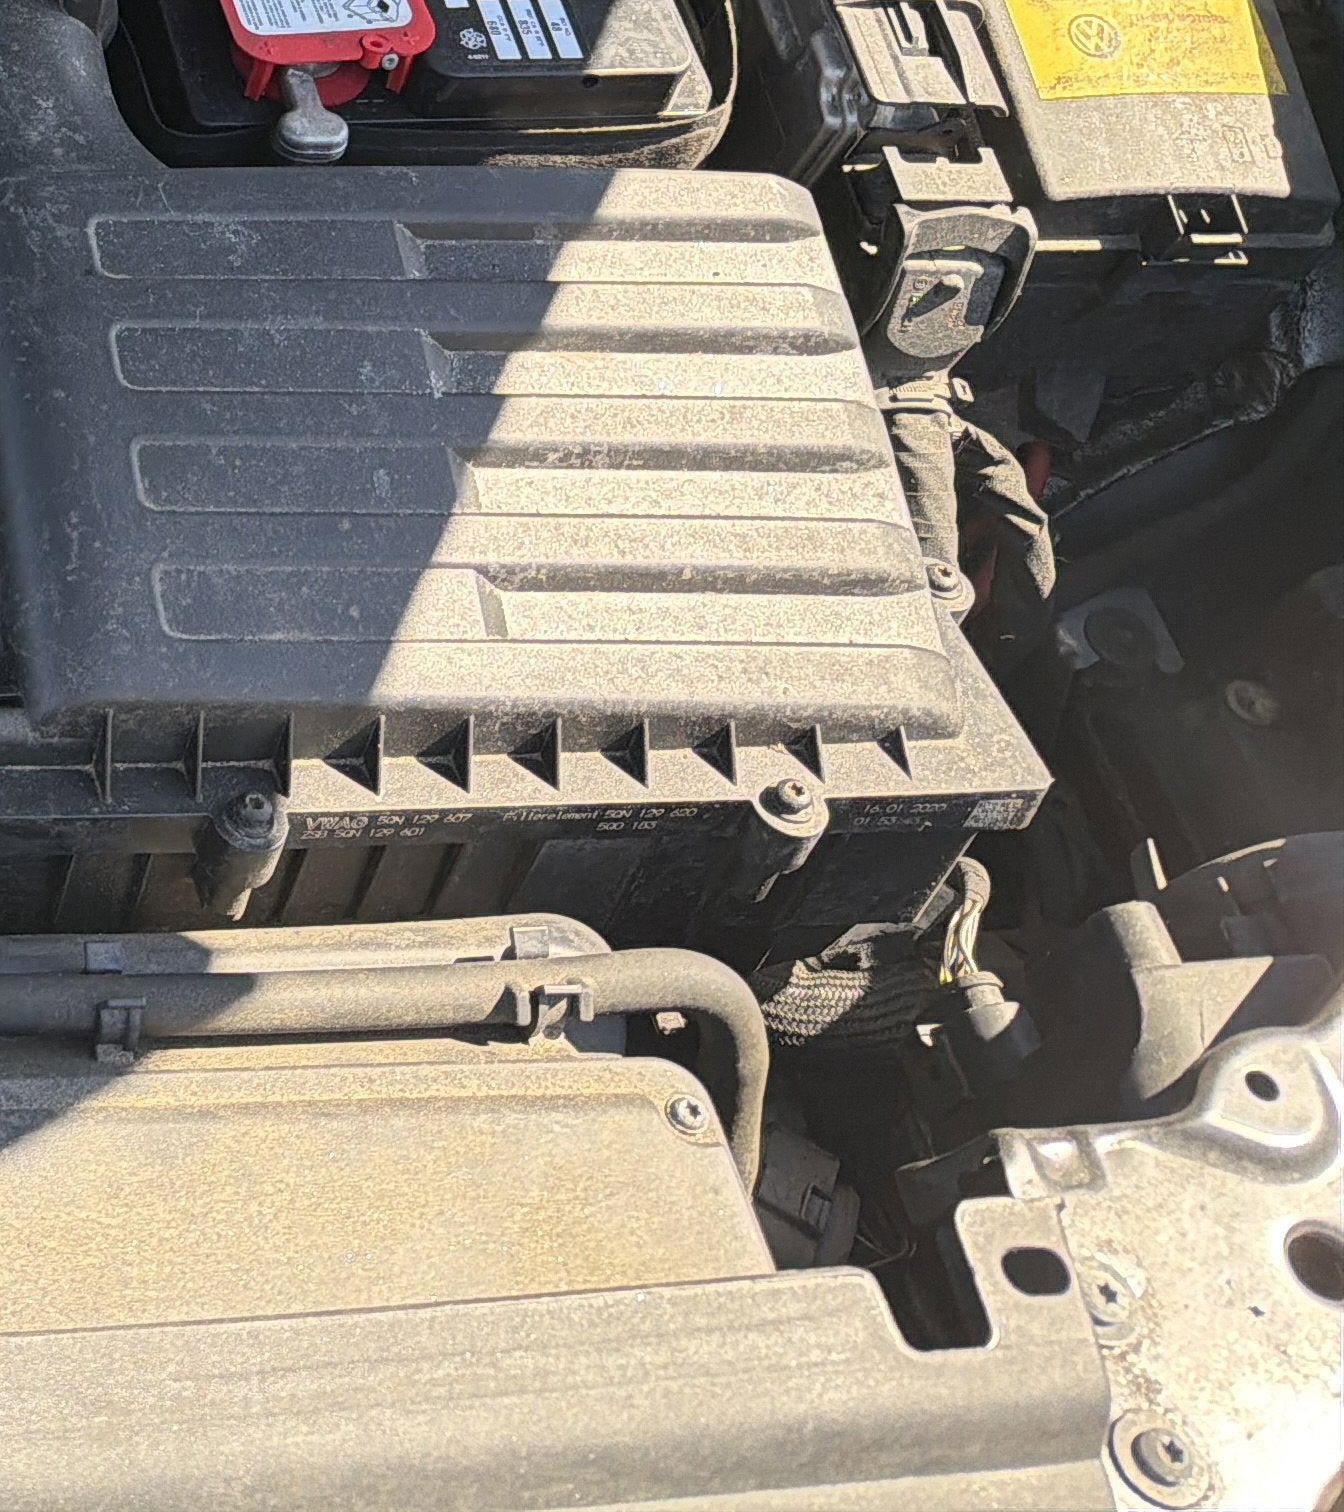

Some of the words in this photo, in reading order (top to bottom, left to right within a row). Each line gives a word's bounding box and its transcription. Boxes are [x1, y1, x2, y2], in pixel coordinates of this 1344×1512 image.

[413, 814, 439, 825] 129
[502, 810, 599, 823] Filterelement
[639, 808, 665, 819] 129
[369, 828, 394, 838] 129
